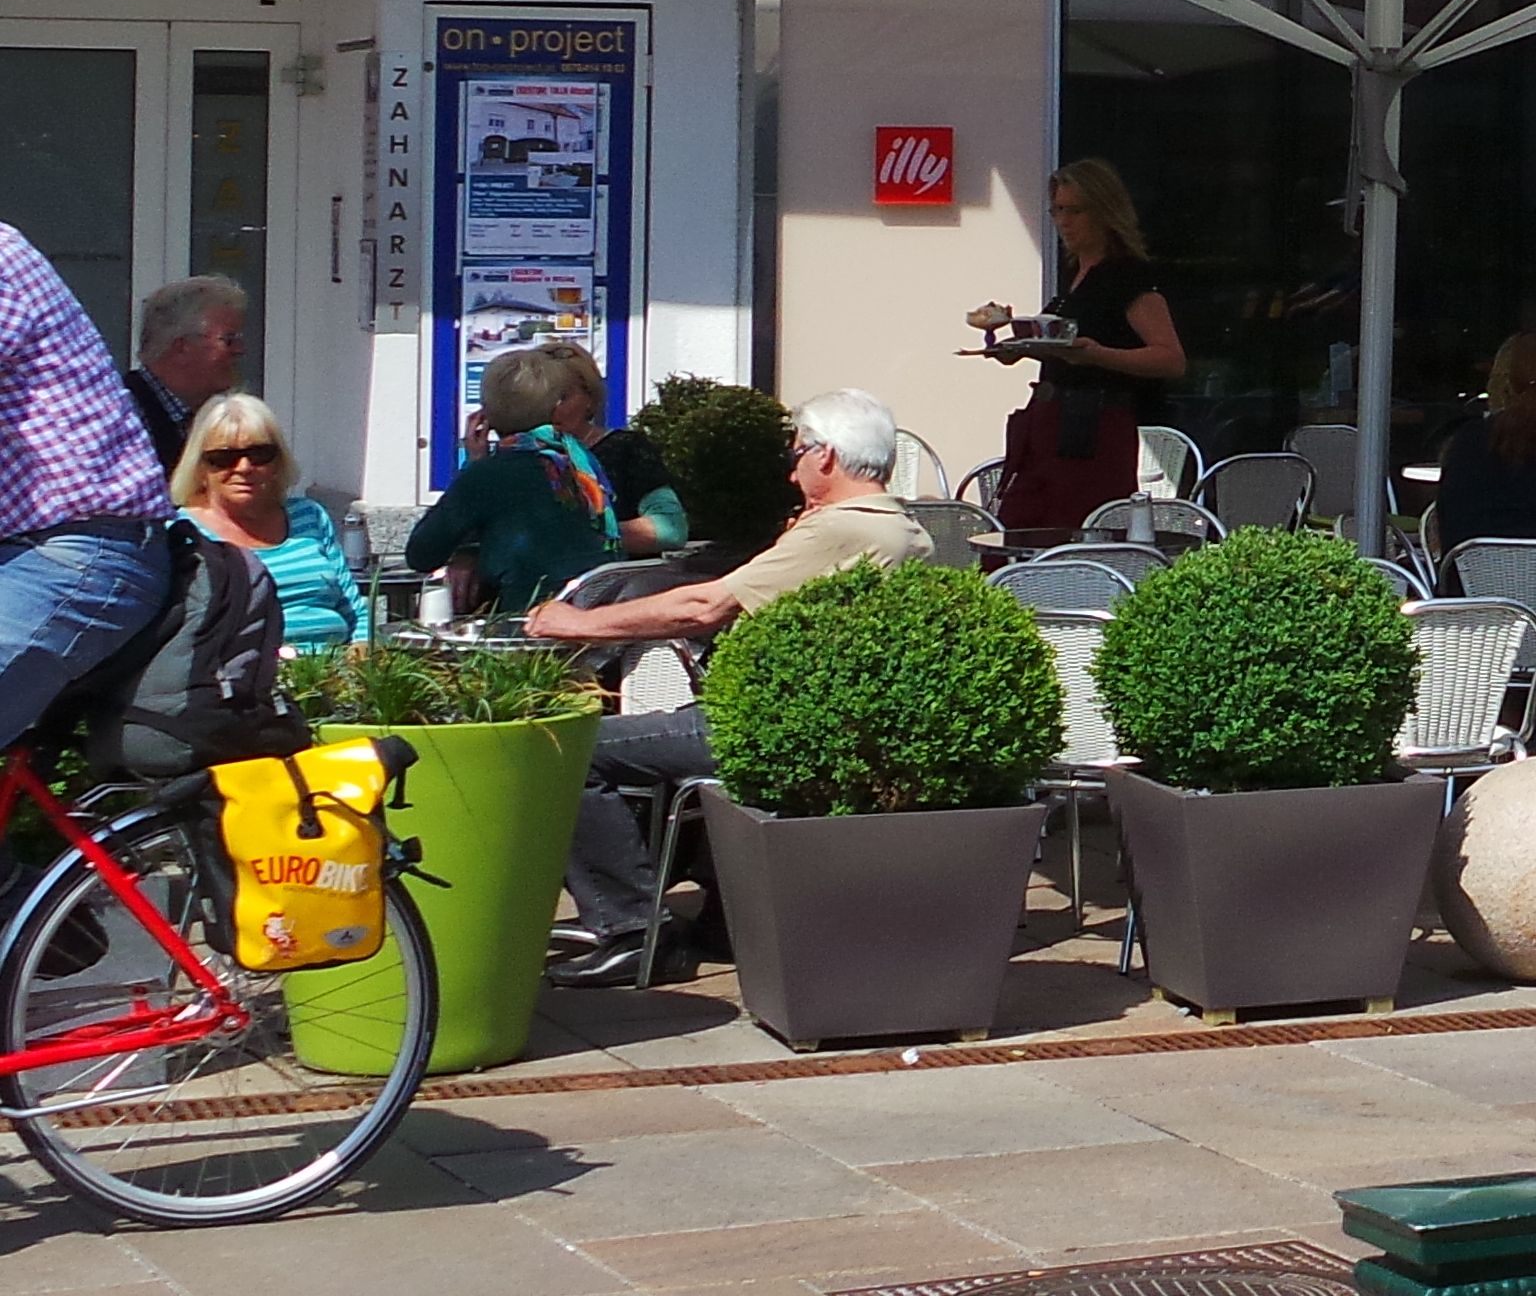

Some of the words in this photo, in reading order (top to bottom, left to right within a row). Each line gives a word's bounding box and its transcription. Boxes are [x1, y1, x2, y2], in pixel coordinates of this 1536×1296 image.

[443, 28, 485, 51] on
[510, 24, 625, 60] project
[388, 68, 409, 320] ZAHNARZT
[880, 135, 949, 196] illy
